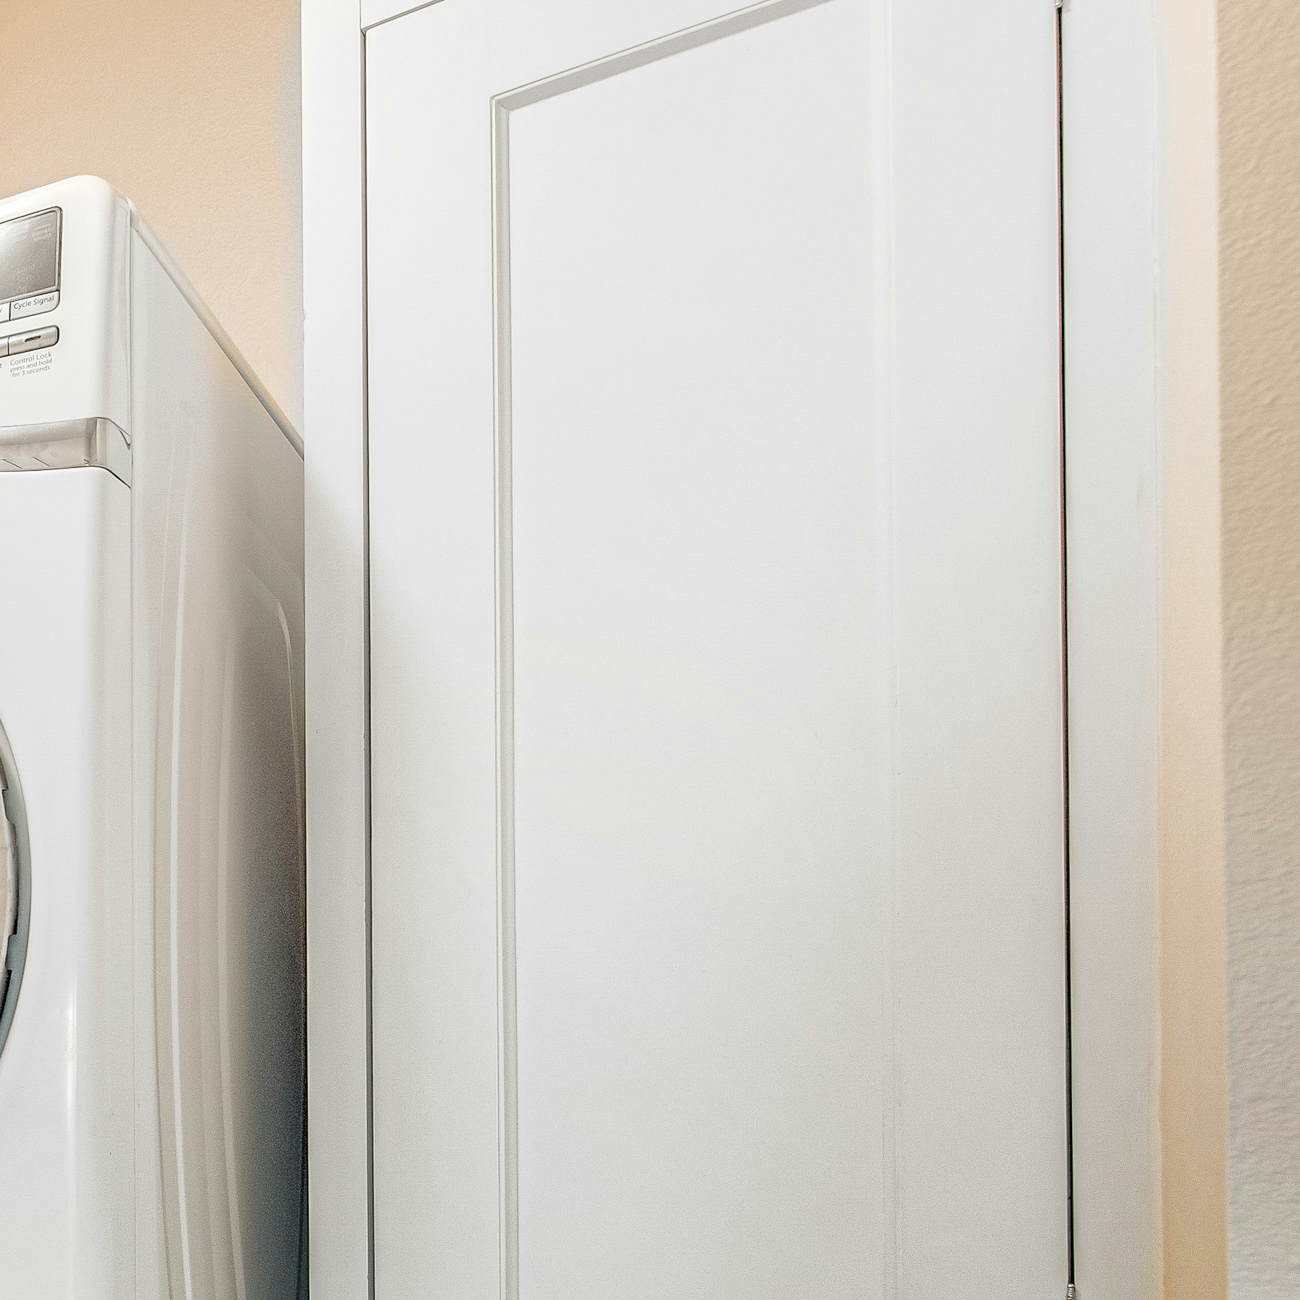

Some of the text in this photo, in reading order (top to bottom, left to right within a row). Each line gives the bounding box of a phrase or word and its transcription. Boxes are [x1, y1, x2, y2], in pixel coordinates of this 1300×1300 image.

[13, 295, 55, 310] Cycle Signal
[10, 351, 52, 366] Control Lock
